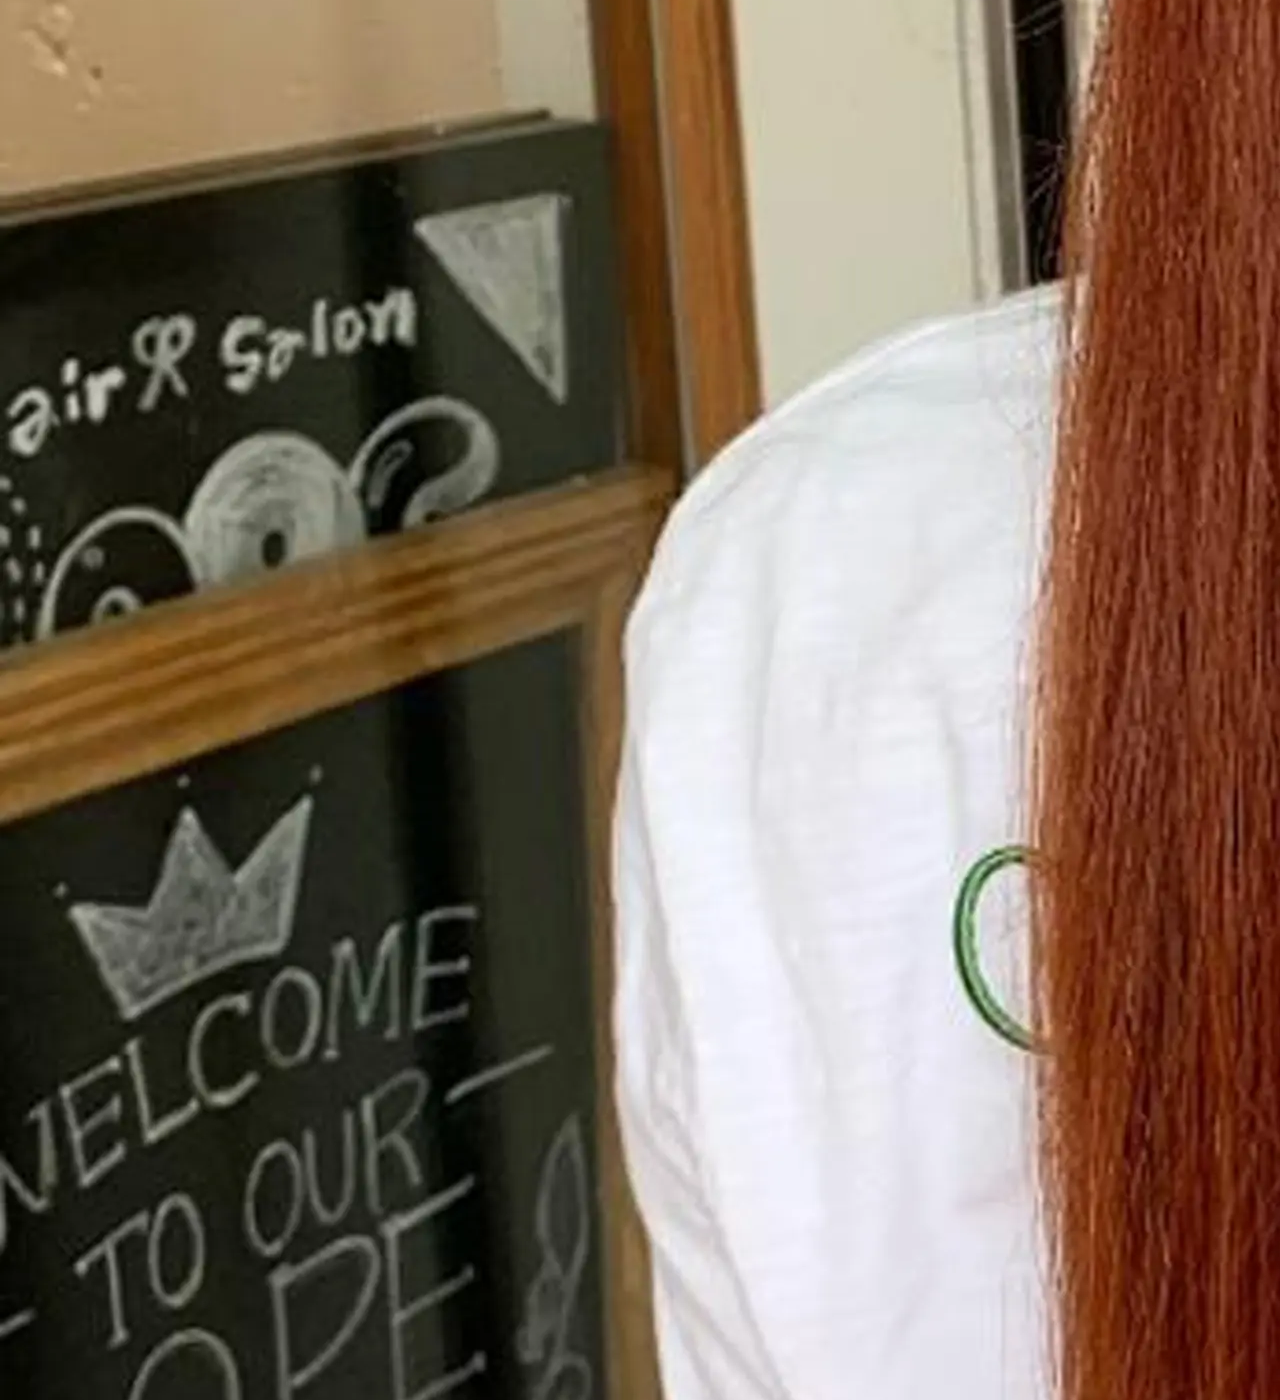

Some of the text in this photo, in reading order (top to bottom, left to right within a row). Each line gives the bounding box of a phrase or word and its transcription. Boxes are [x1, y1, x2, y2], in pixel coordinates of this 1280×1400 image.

[220, 288, 418, 394] Salon
[73, 1068, 430, 1348] TO OUR
